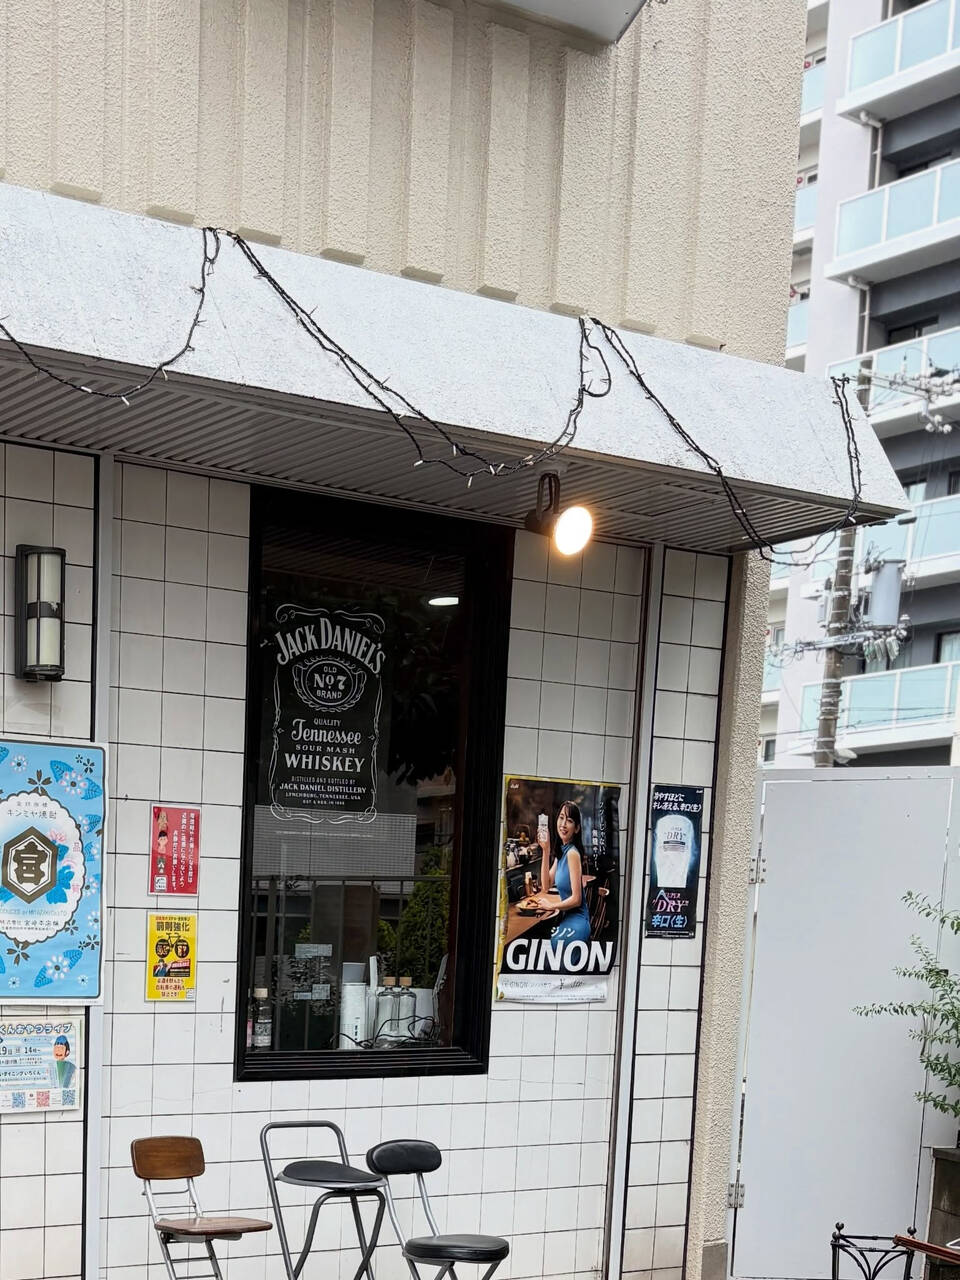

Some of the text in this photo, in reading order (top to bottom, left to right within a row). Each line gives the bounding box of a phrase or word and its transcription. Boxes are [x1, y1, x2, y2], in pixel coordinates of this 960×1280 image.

[275, 617, 386, 675] JACK DANIEL'S
[323, 665, 337, 673] OLD
[316, 689, 342, 700] BRAND
[313, 718, 342, 727] QUALITY
[291, 718, 361, 745] Tennessee
[296, 744, 355, 754] SOUR MASH
[285, 752, 365, 773] WHISKEY
[279, 783, 367, 794] JACK DANIEL DISTILLERY
[551, 927, 575, 937] ジノン
[506, 938, 613, 972] GINON
